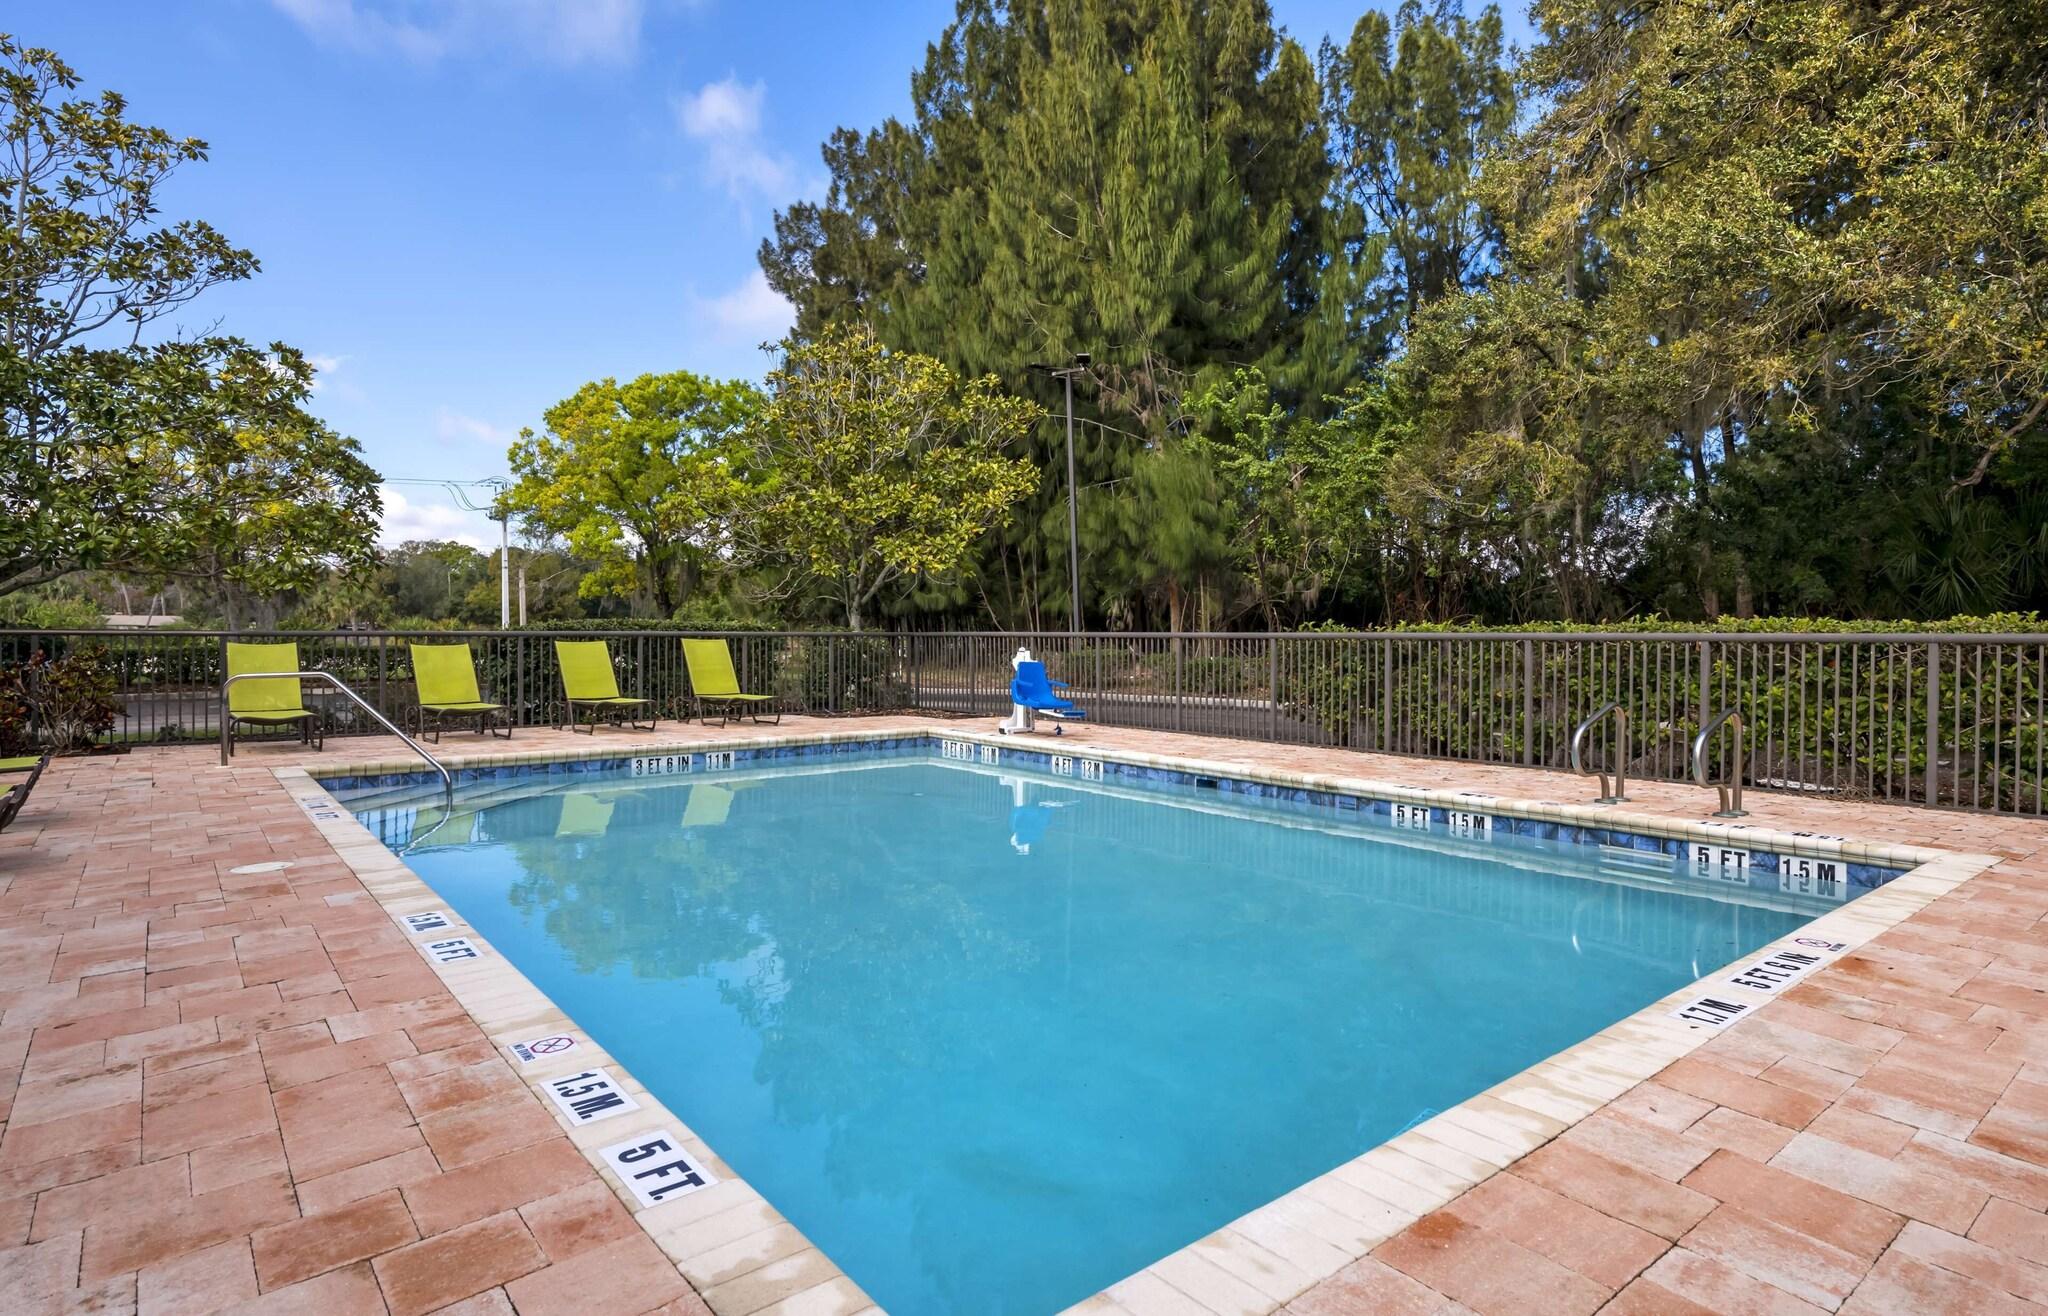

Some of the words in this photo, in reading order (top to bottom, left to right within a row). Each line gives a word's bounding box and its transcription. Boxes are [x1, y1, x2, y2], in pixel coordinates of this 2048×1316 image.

[1397, 805, 1405, 819] 5
[1412, 808, 1428, 820] FT
[1473, 816, 1485, 829] M
[1697, 846, 1710, 863] 5
[1721, 849, 1746, 868] FT
[431, 940, 466, 949] 5
[1764, 961, 1801, 971] 6
[1744, 968, 1792, 983] FT
[1731, 978, 1772, 989] 5
[617, 1138, 673, 1164] 5
[633, 1159, 706, 1201] FT.
